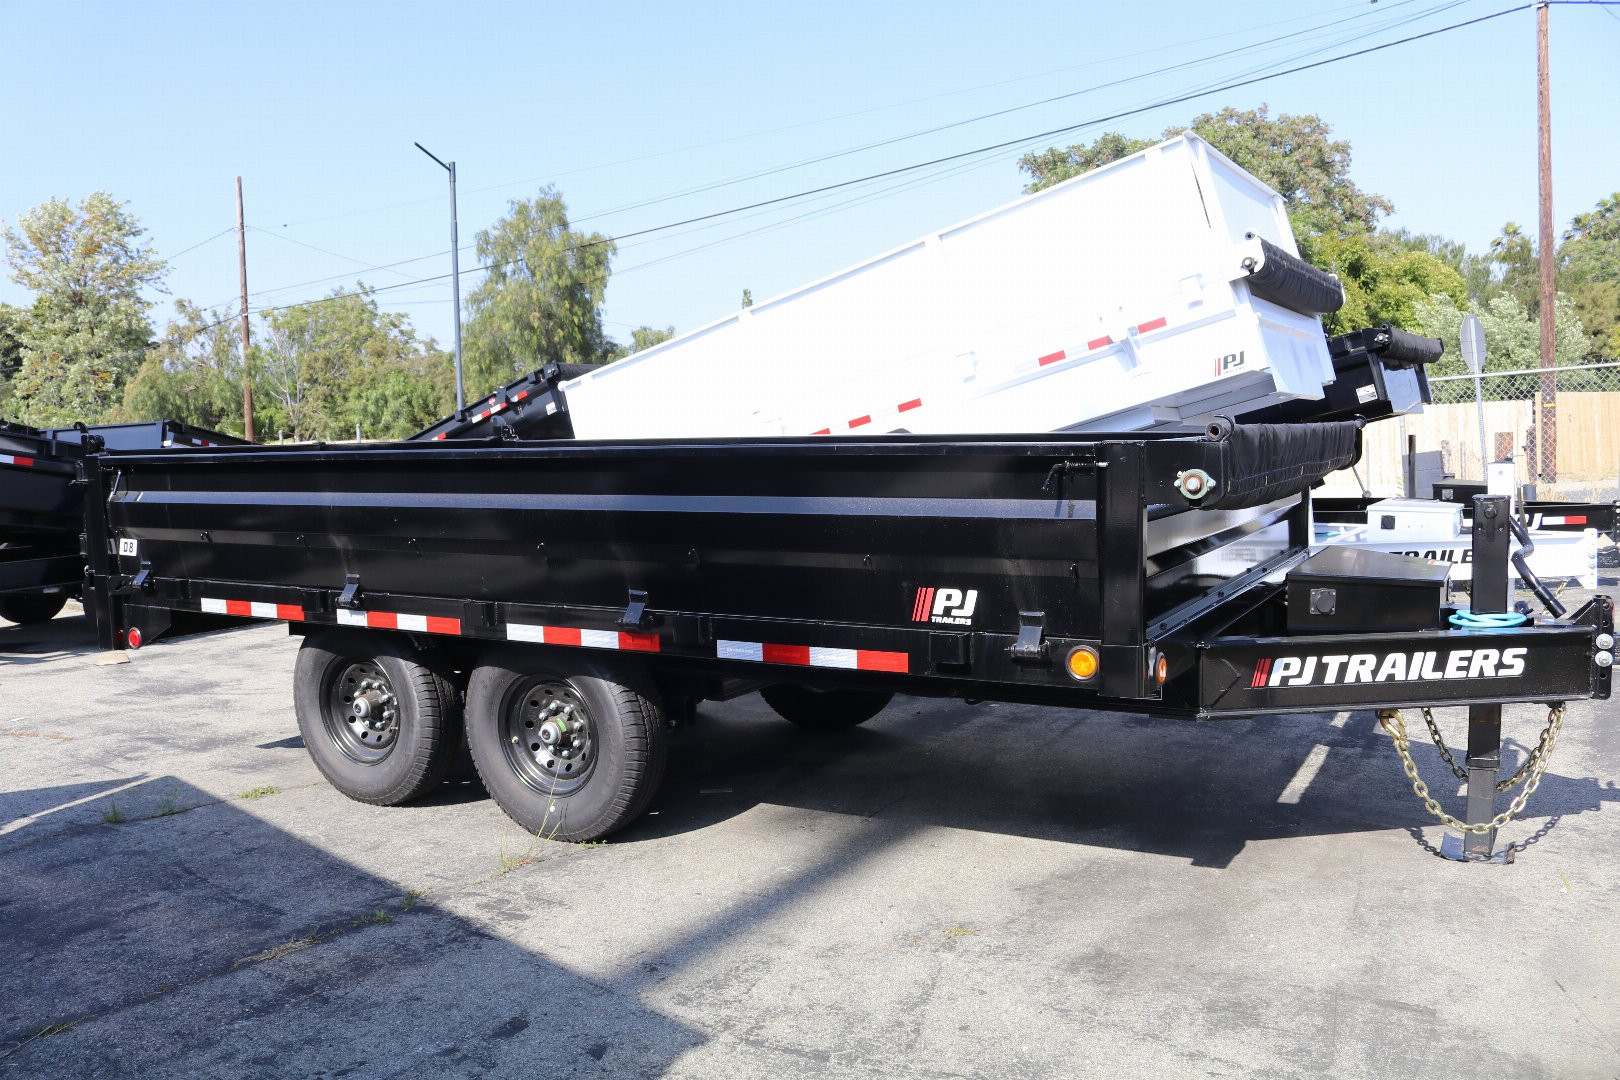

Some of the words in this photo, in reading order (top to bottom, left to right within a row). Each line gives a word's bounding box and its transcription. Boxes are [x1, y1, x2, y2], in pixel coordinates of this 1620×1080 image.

[1223, 350, 1245, 370] PJ
[123, 541, 134, 553] D8
[932, 588, 978, 617] PJ
[931, 616, 972, 626] TRAILERS
[1268, 656, 1318, 687] PJ
[1323, 647, 1528, 684] TRAILERS
